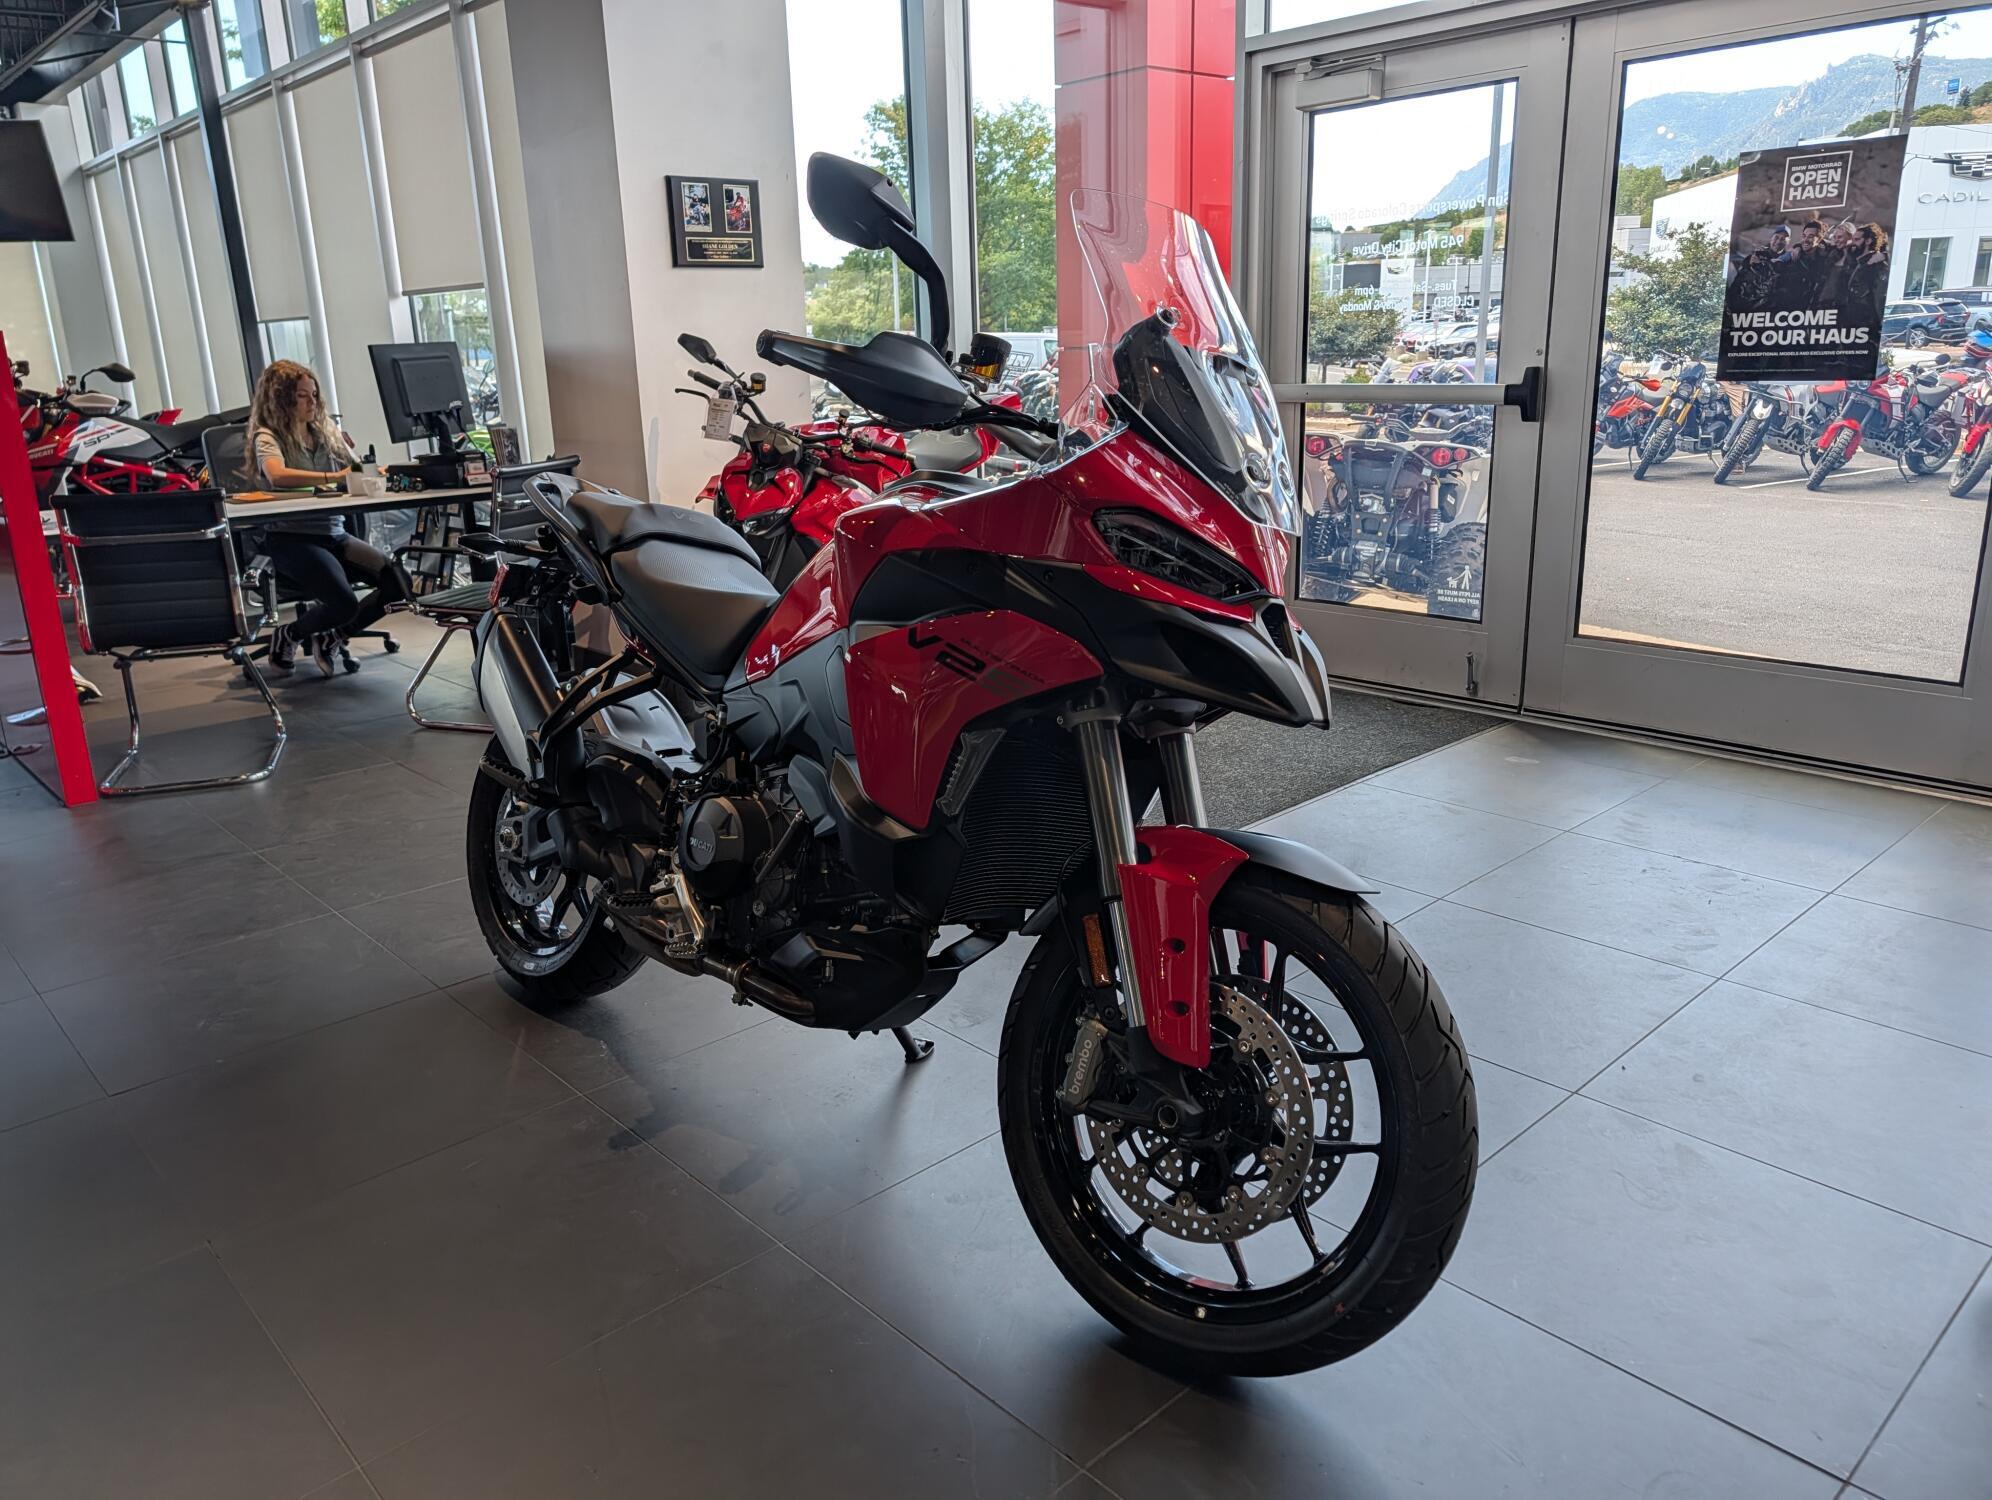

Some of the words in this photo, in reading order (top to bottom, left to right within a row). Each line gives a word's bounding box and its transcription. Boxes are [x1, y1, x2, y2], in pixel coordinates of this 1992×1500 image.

[1808, 161, 1843, 170] MOTORRAD
[1790, 167, 1842, 186] OPEN
[1788, 182, 1840, 201] HAUS
[1732, 309, 1838, 329] WELCOME
[1730, 330, 1758, 347] TO
[1760, 328, 1806, 346] OUR
[1809, 326, 1870, 345] HAUS
[689, 836, 714, 854] DUCATI
[1068, 1039, 1093, 1095] brembo
